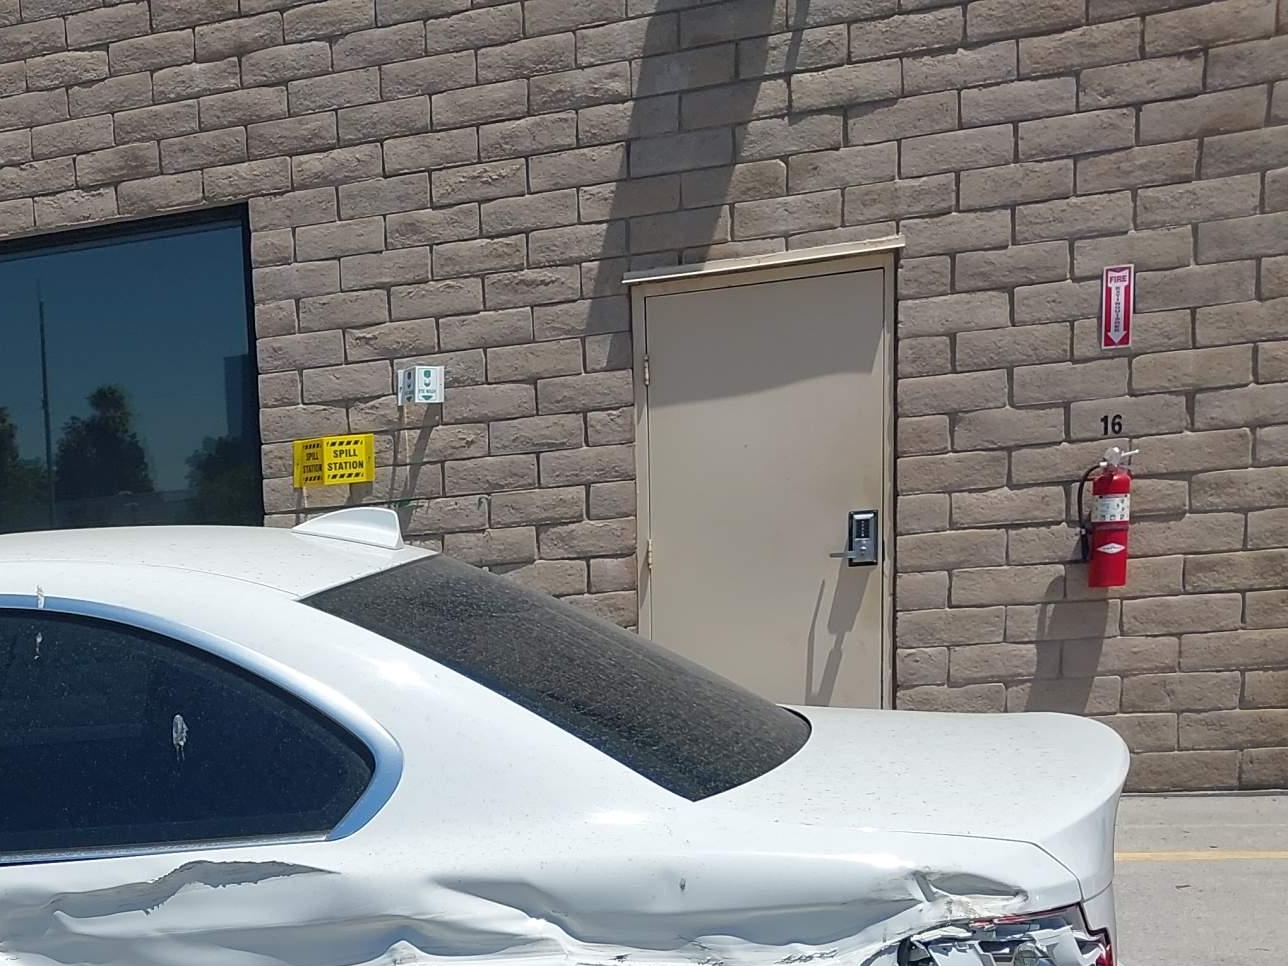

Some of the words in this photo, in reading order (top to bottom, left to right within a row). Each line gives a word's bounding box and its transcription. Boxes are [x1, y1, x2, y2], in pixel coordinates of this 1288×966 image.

[1109, 275, 1128, 284] FIRE
[1100, 414, 1122, 436] 16
[305, 452, 319, 461] SPILL
[332, 449, 358, 459] SPILL
[327, 460, 364, 472] STATION
